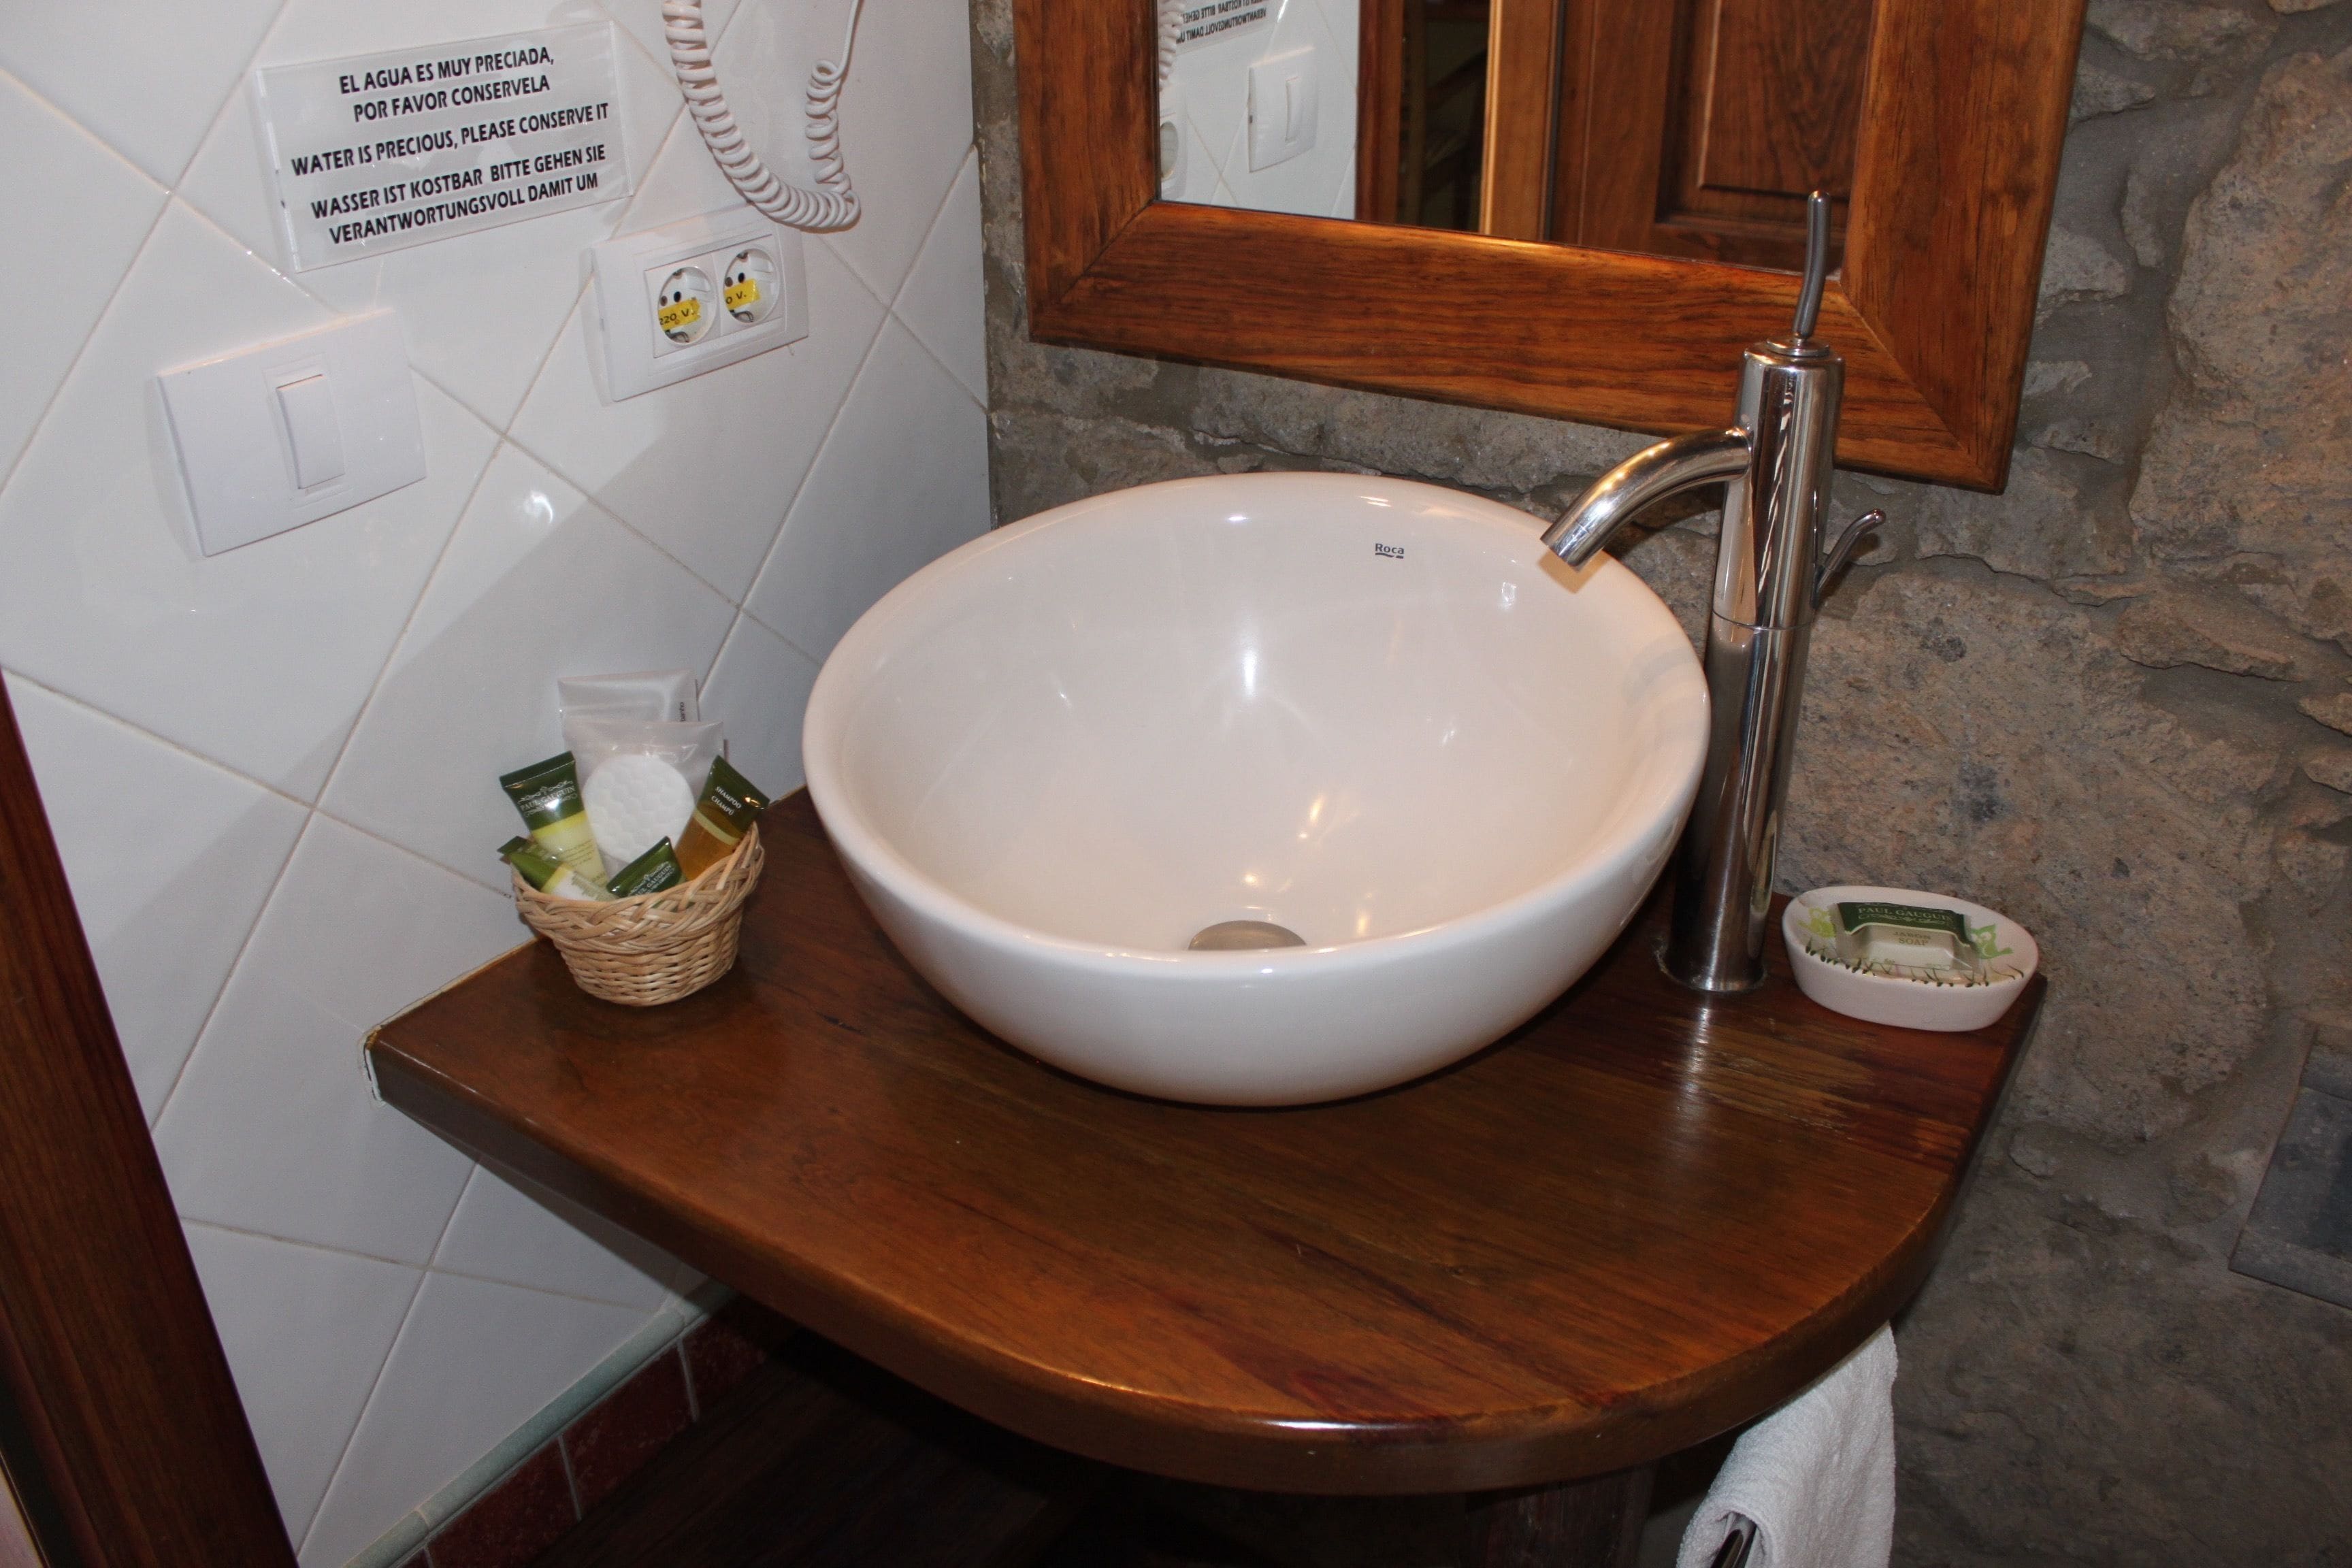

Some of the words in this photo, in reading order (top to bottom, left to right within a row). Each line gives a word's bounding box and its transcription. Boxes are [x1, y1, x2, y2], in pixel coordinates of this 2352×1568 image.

[339, 75, 360, 94] EL
[364, 67, 413, 91] AGUA
[416, 63, 434, 82] ES
[438, 57, 471, 79] MUY
[475, 46, 554, 74] PRECIADA,
[353, 100, 388, 122] POR
[391, 91, 448, 116] FAVOR
[451, 75, 550, 106] CONSERVELA
[291, 148, 355, 176] WATER
[358, 144, 372, 164] IS
[376, 130, 458, 161] PRECIOUS,
[461, 119, 516, 145] PLEASE
[519, 105, 593, 134] CONSERVE
[596, 102, 608, 120] IT
[311, 189, 380, 219] WASSER
[383, 183, 406, 204] IST
[410, 168, 483, 199] KOSTBAR
[490, 159, 531, 182] BITTE
[534, 148, 583, 173] GEHEN
[585, 144, 606, 163] SIE
[329, 188, 525, 244] VERANTWORTUNGSVOLL
[527, 177, 573, 202] DAMIT
[576, 172, 598, 191] UM
[659, 313, 676, 325] 220
[1375, 543, 1405, 555] Roca
[519, 800, 542, 812] PAUL
[540, 785, 576, 804] GAUGUIN
[715, 786, 742, 808] SHAMPOO
[1858, 907, 1893, 915] PAUL
[1895, 910, 1953, 922] GAUGUIN
